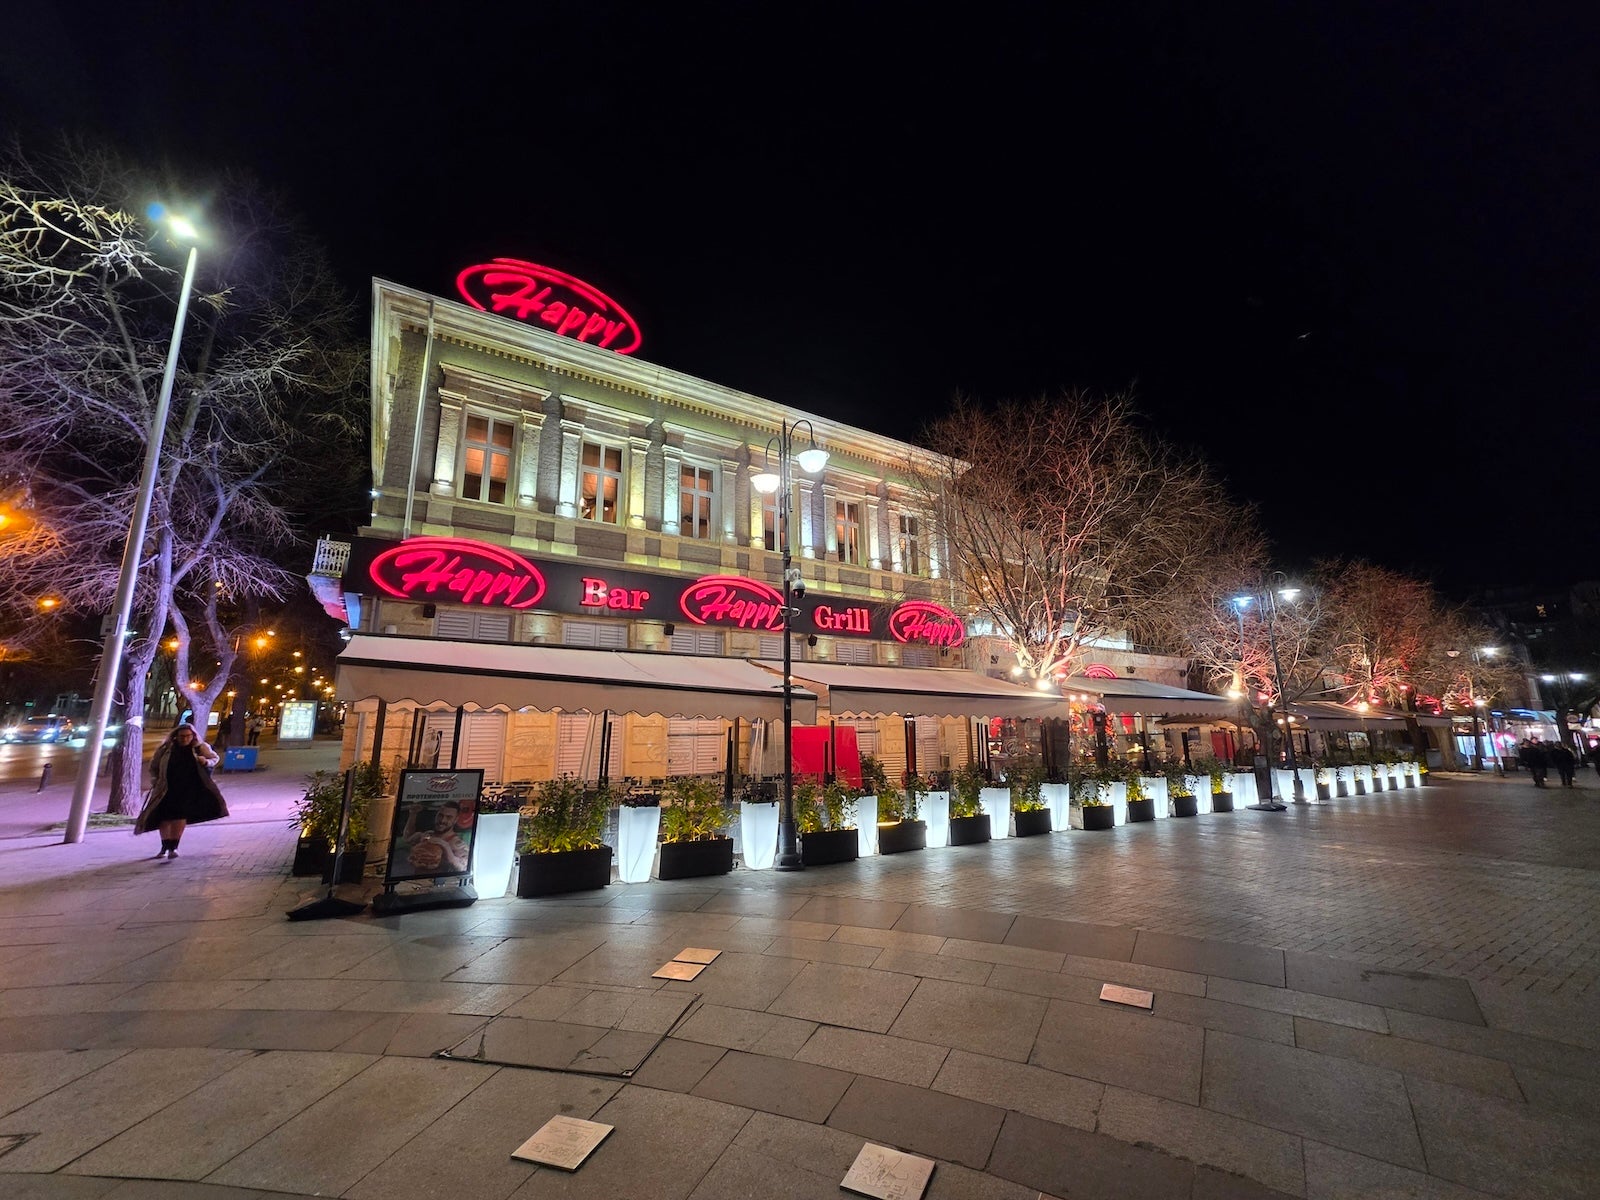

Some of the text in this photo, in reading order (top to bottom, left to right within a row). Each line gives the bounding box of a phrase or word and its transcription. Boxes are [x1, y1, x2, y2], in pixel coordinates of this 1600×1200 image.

[484, 272, 626, 348] Happy
[395, 550, 959, 645] Happy Bar Happy Grill Happy
